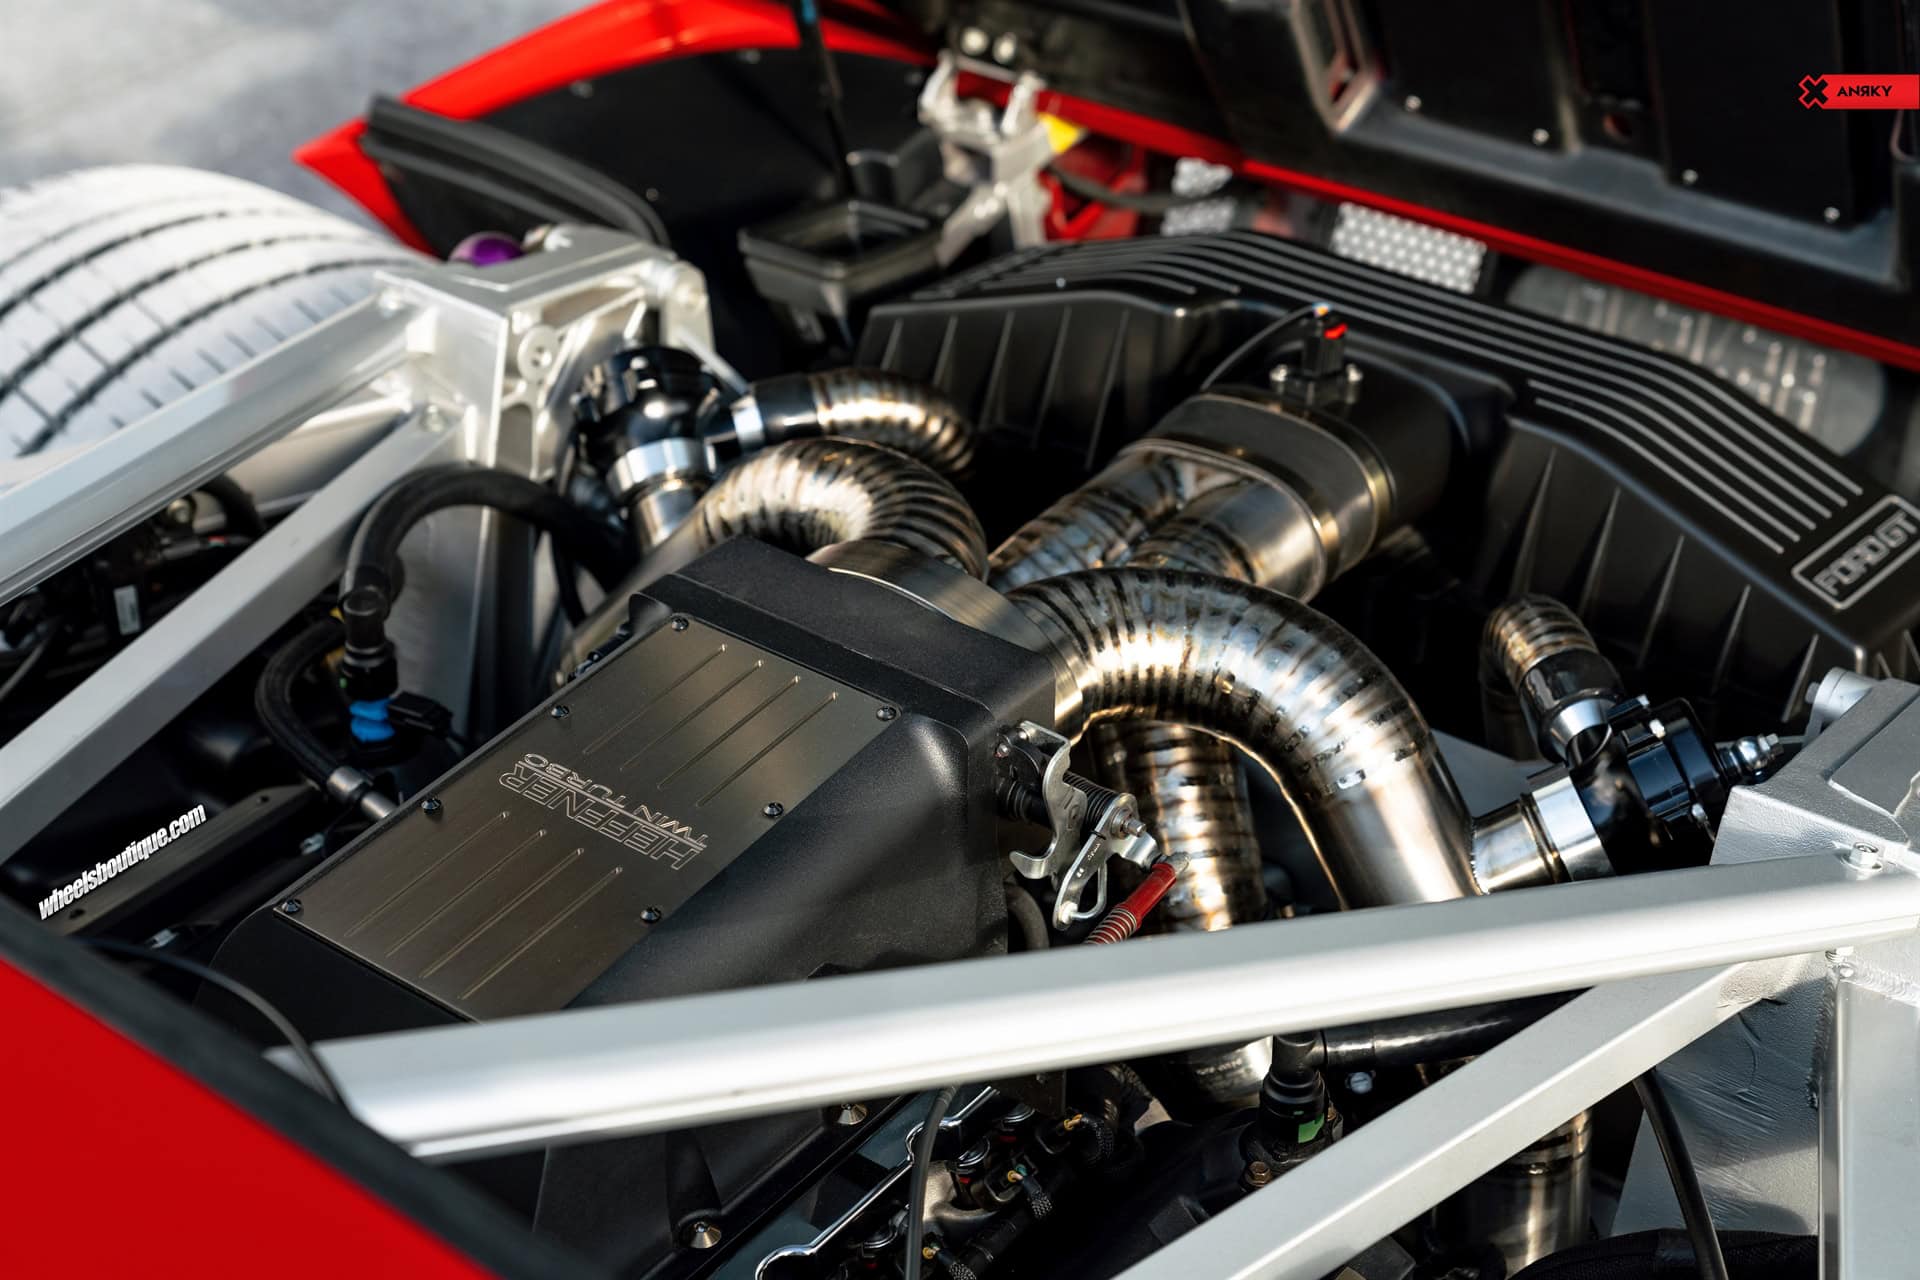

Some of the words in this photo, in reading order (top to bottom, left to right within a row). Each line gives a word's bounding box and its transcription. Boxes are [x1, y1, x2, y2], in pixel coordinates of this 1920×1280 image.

[524, 753, 627, 808] TURBO
[500, 763, 703, 870] HEFFNER
[633, 804, 709, 848] TWIN
